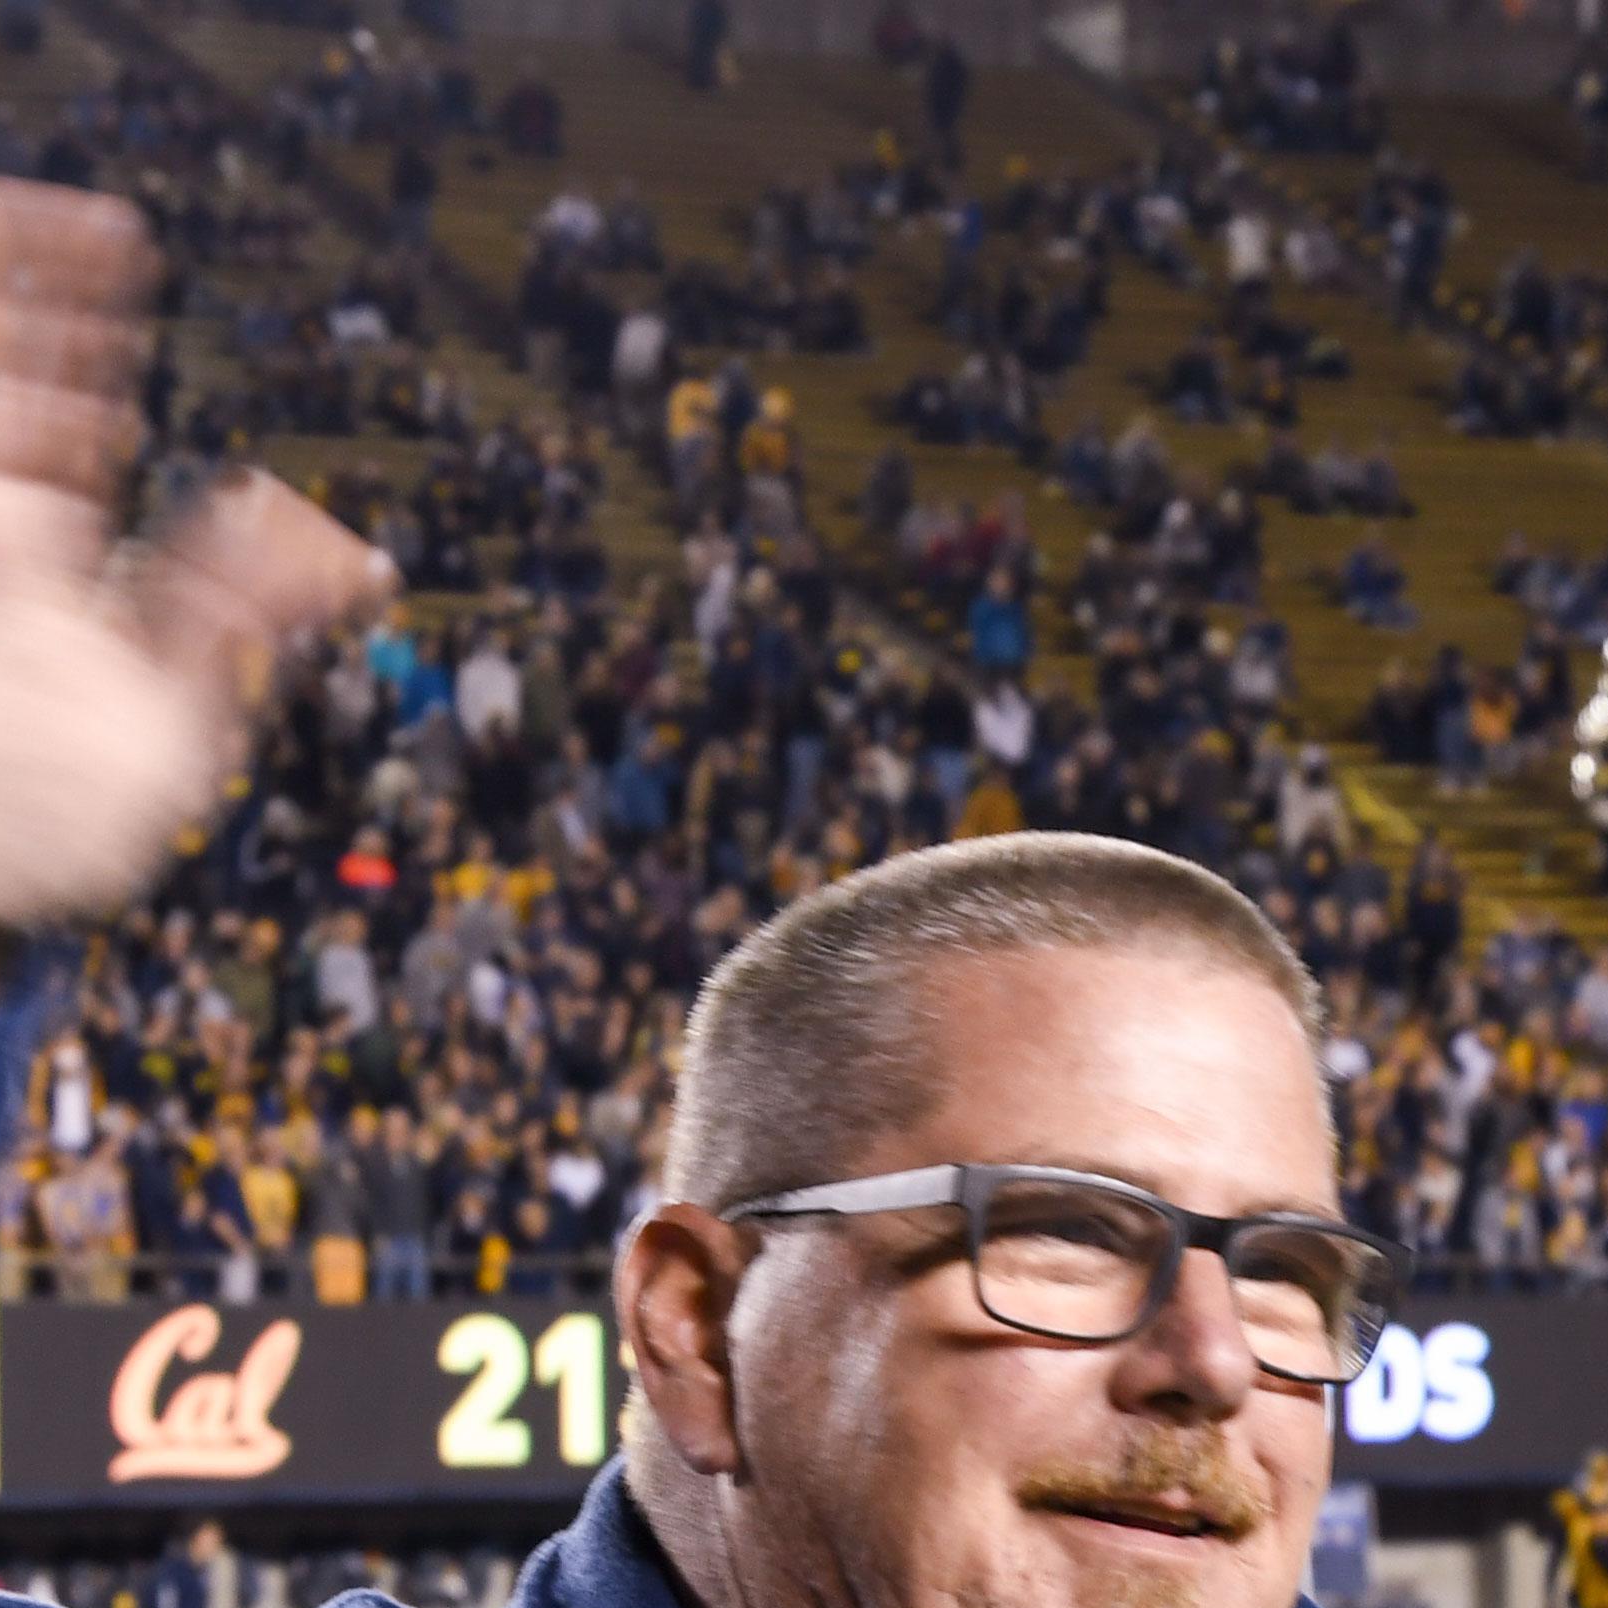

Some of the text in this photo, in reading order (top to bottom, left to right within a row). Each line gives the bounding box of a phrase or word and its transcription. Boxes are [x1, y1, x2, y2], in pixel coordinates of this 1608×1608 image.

[108, 1303, 302, 1483] Cal
[436, 1311, 639, 1467] 21
[1326, 1321, 1495, 1443] DS
